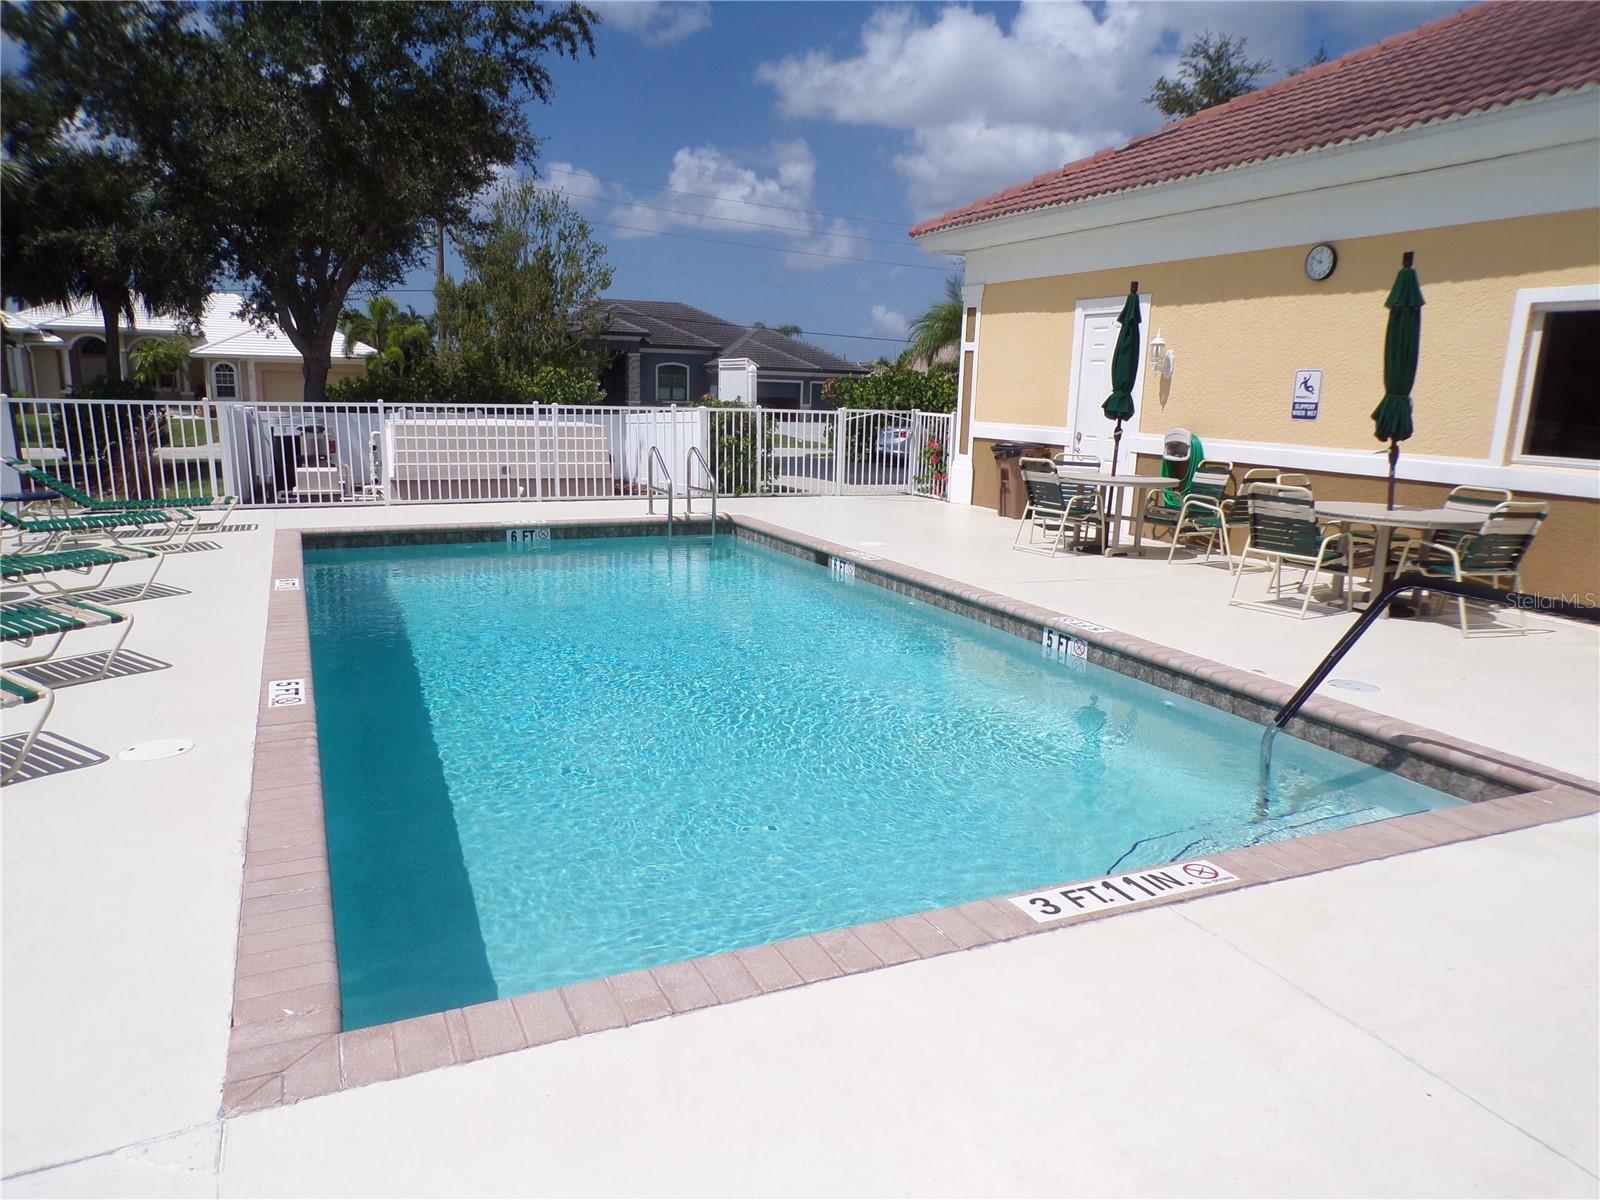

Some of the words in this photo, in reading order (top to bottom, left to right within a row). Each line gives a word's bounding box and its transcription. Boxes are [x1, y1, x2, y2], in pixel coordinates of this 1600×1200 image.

[511, 530, 518, 542] 6
[522, 530, 535, 541] FT
[1046, 629, 1054, 648] 5
[1057, 633, 1071, 654] FT
[1029, 897, 1062, 915] 3
